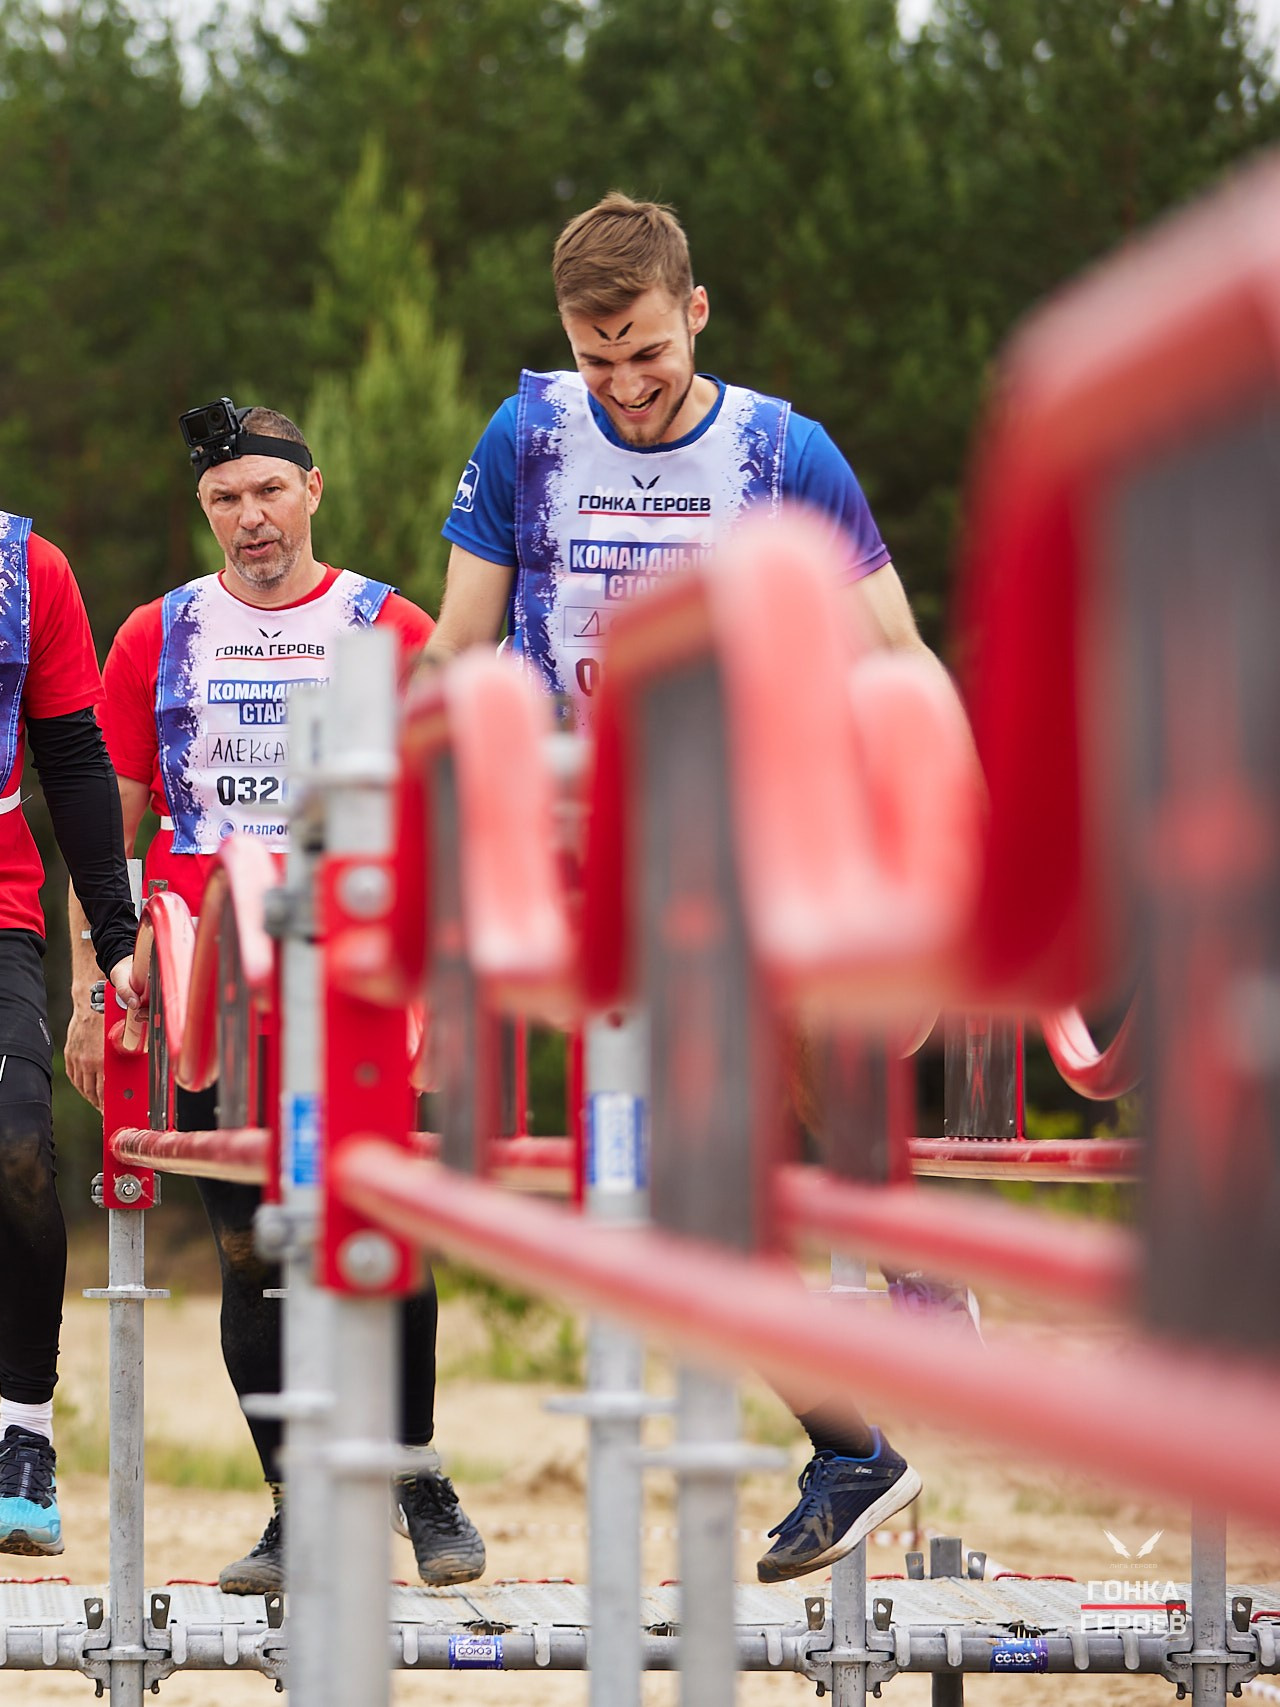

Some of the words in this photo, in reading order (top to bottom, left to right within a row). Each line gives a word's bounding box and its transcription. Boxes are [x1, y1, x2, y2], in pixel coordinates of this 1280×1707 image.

[578, 495, 636, 511] ГОНКА
[642, 497, 711, 512] ГЕРОЕВ
[215, 645, 264, 657] ГОНКА
[268, 643, 325, 656] ГЕРОЕВ
[209, 677, 330, 703] КОМАНД
[242, 703, 289, 724] СТАР
[210, 737, 289, 764] АЛЕКСА
[216, 775, 289, 806] 032
